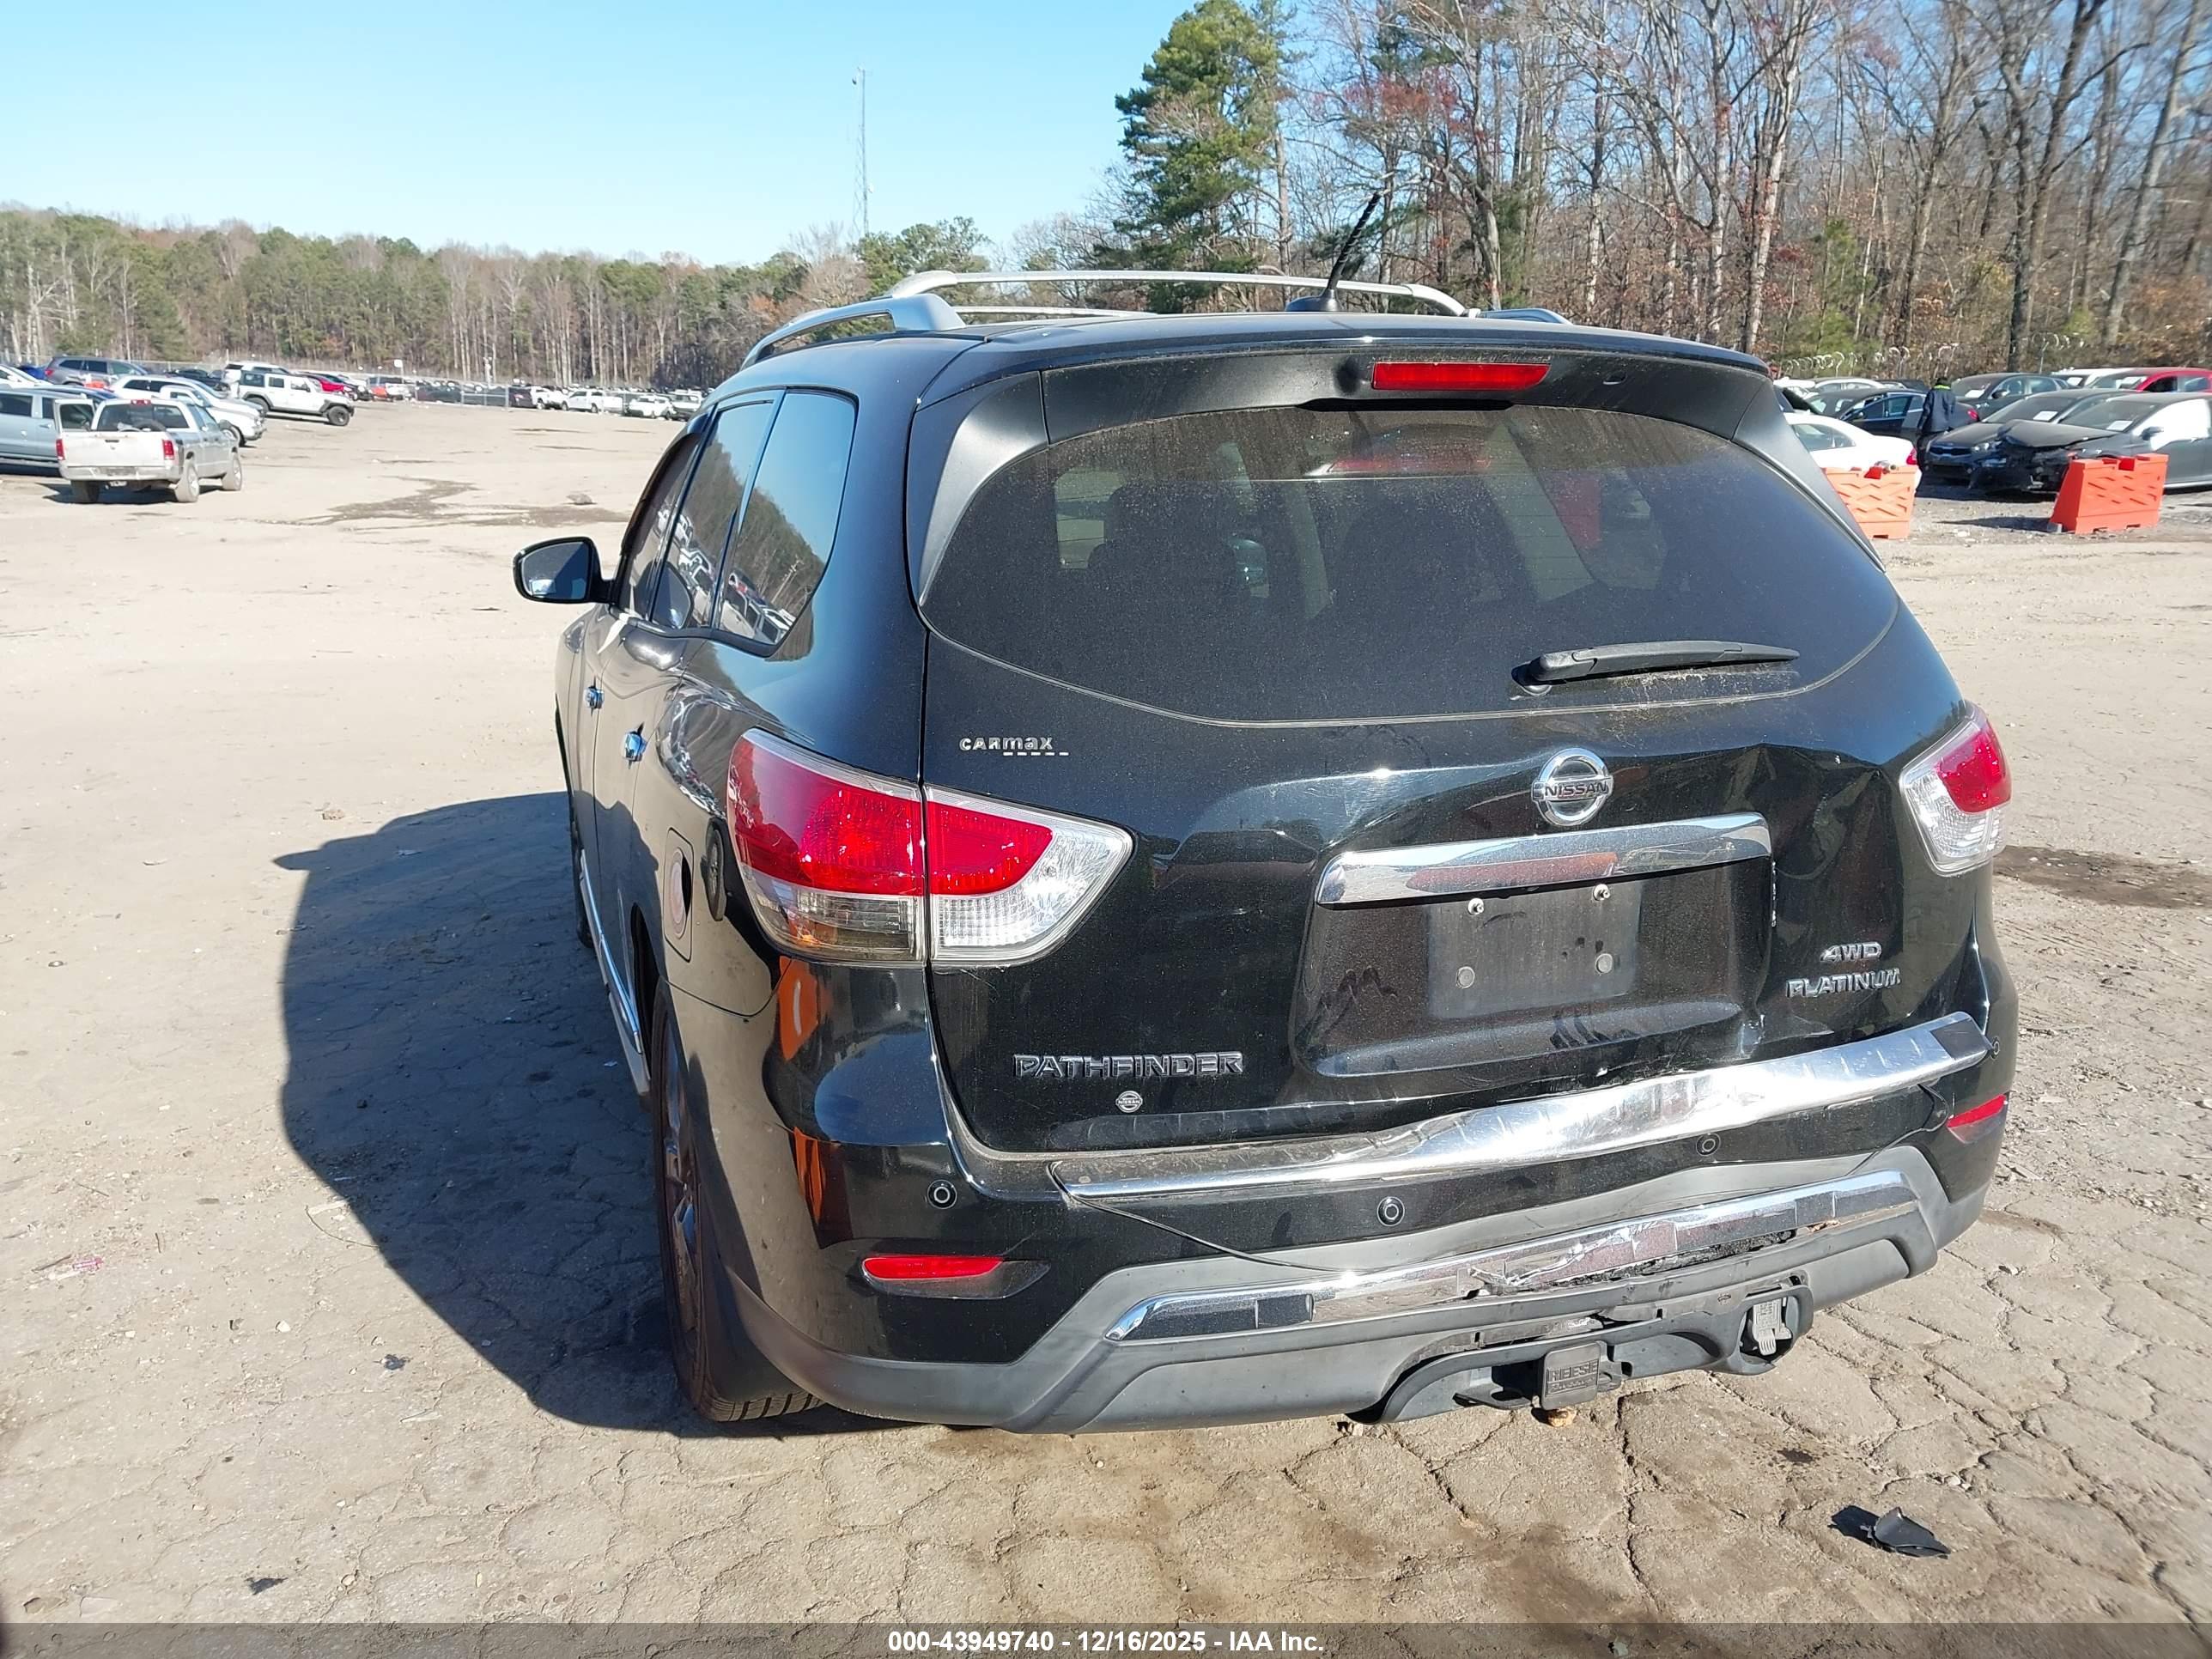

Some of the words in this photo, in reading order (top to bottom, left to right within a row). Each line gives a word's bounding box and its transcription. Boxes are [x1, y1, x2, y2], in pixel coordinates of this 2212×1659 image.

[1544, 781, 1607, 797] NISSAN
[1820, 941, 1883, 963] 4WD
[1785, 967, 1902, 998] PLATINUM
[1012, 1051, 1243, 1078] PATHFINDER
[1548, 1358, 1599, 1382] REESE
